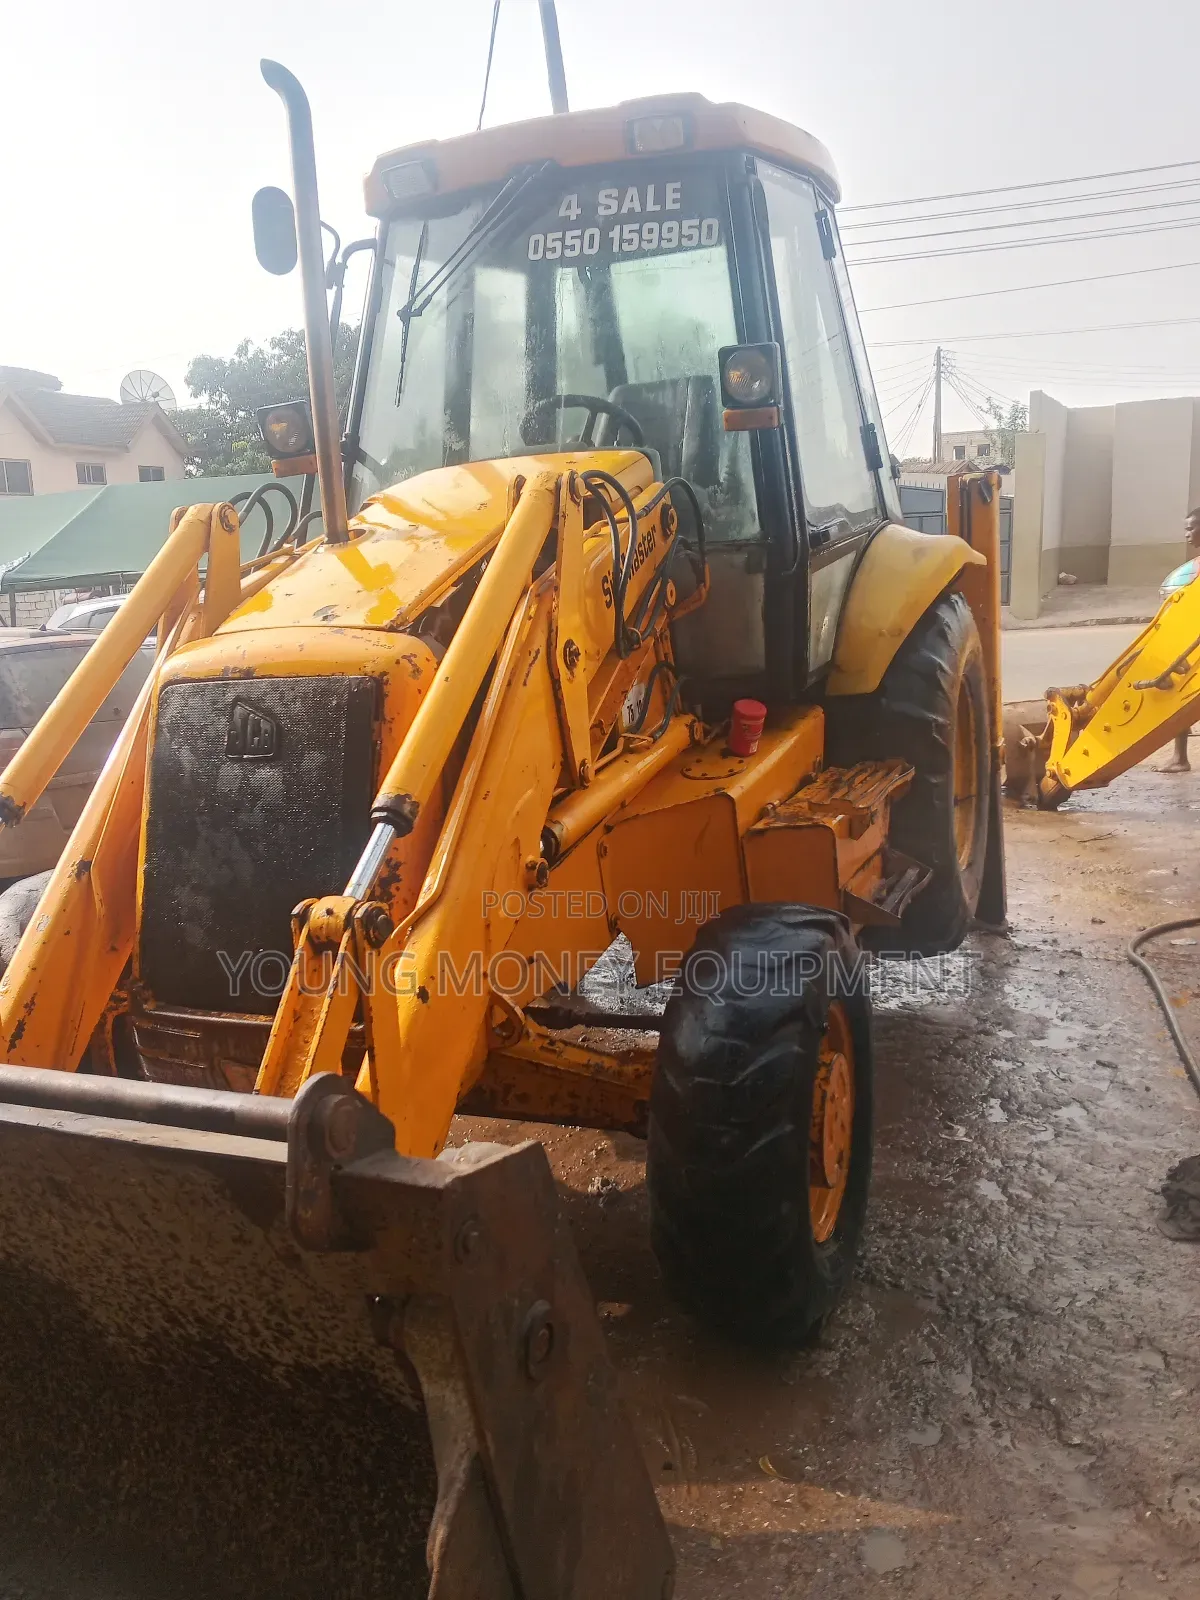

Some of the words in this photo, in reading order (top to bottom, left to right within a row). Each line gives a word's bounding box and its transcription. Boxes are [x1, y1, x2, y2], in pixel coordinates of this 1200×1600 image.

[558, 193, 582, 221] 4
[597, 181, 682, 216] SALE
[527, 227, 601, 261] 0550
[608, 217, 720, 253] 159950
